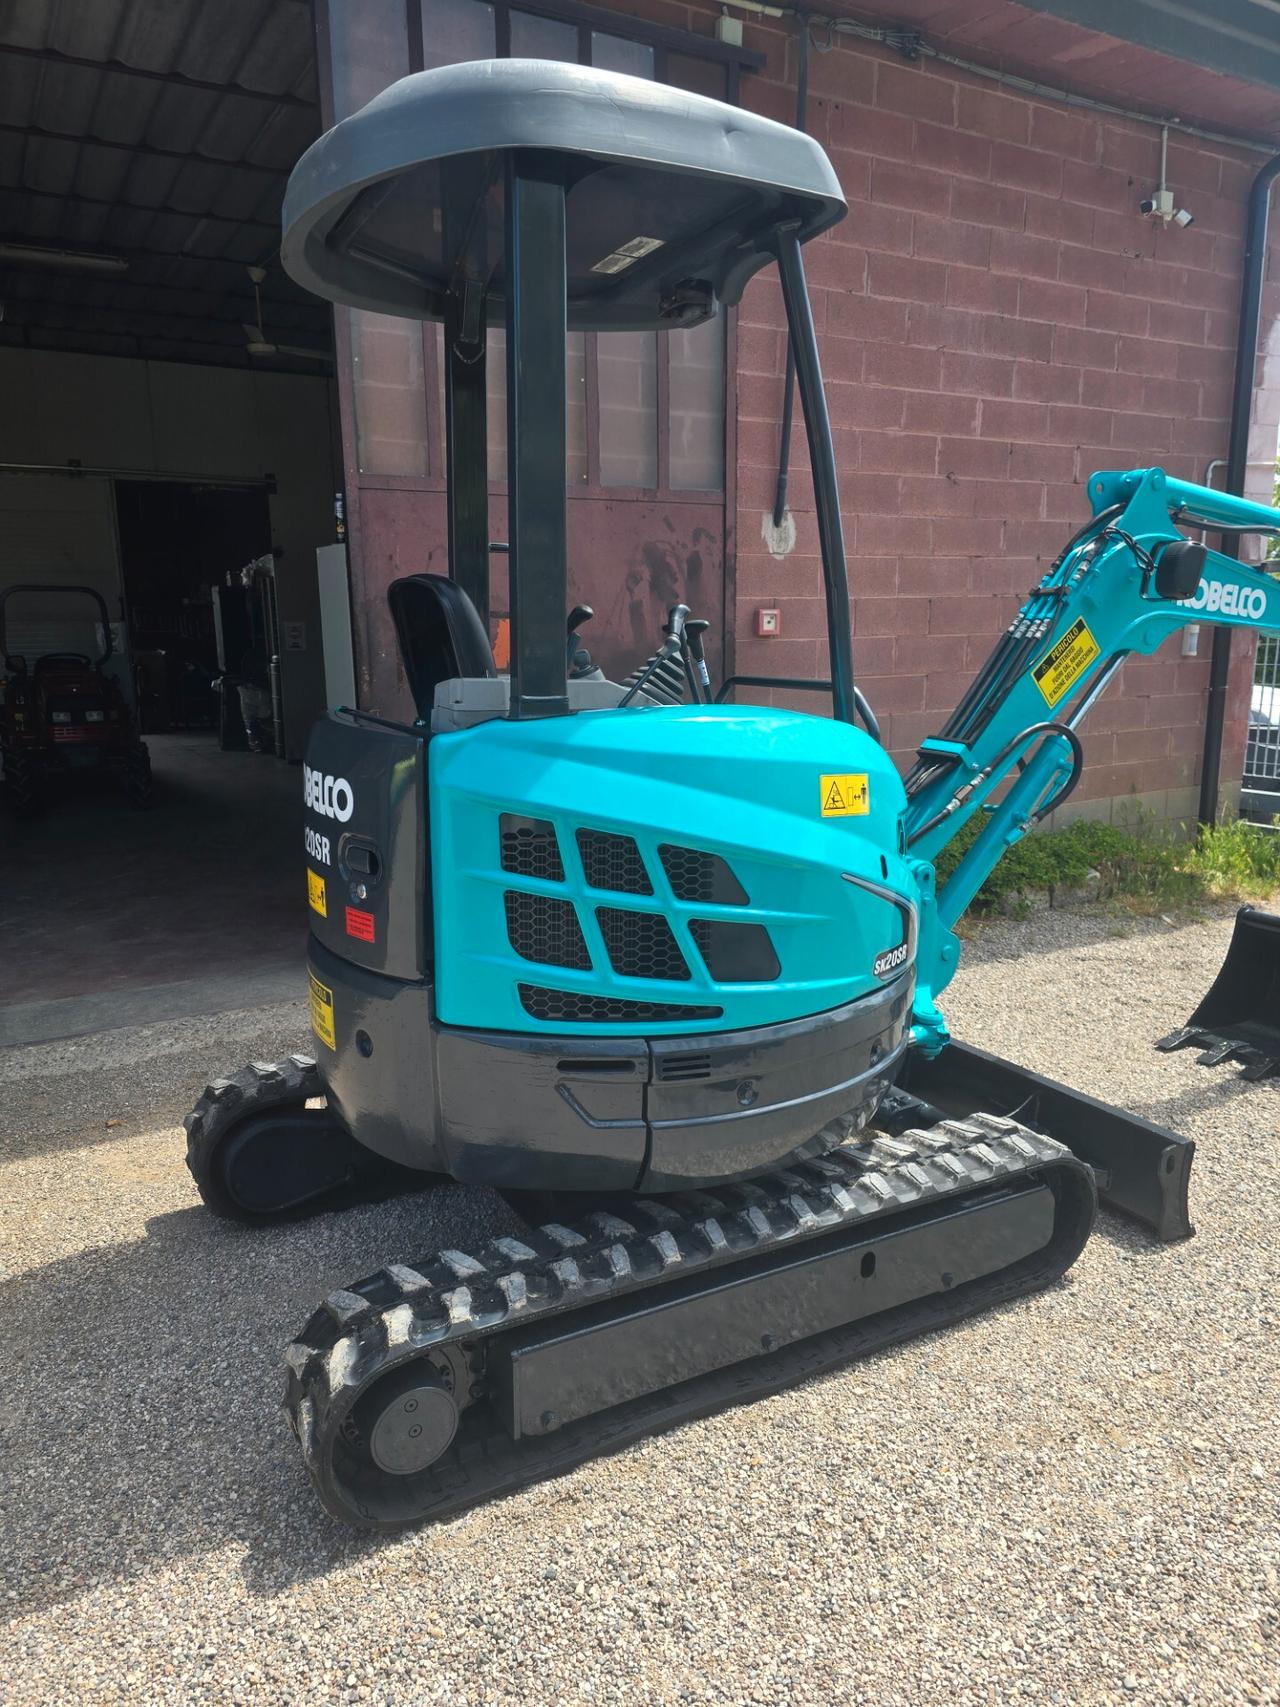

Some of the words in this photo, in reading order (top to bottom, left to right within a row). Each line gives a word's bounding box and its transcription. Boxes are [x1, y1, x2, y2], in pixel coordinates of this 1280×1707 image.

[1176, 578, 1267, 620] OBELCO
[1051, 626, 1079, 661] PERICOLO
[303, 762, 354, 823] BELCO
[304, 825, 331, 866] 20SR
[874, 943, 908, 975] SK20SR
